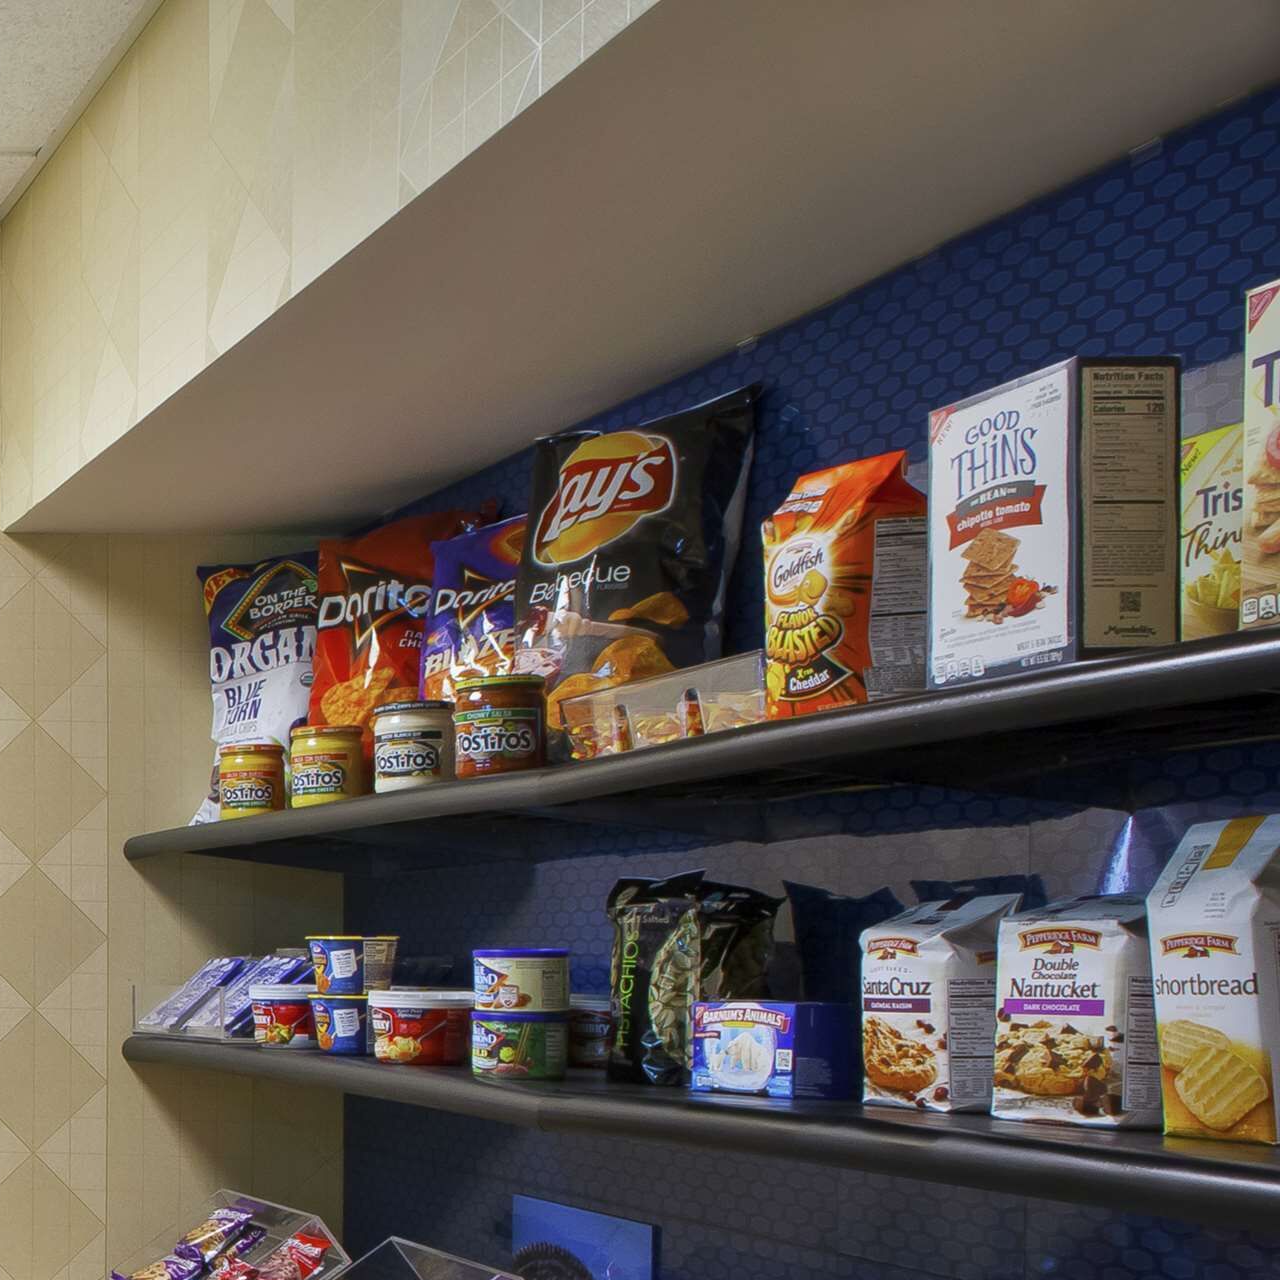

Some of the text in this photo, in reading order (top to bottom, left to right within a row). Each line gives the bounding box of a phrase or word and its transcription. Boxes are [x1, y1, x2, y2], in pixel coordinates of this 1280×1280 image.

[1093, 372, 1164, 380] Nutrition Facts
[965, 410, 1020, 445] GOOD
[951, 427, 1039, 500] THINS
[544, 453, 665, 543] Lay's
[980, 488, 1006, 504] BEAN
[1196, 481, 1243, 518] Tris
[957, 502, 1031, 532] chipotle tomato
[1181, 521, 1242, 567] Thin
[774, 548, 824, 589] Goldfish
[249, 595, 318, 619] BORDER
[255, 586, 307, 606] ON THE
[318, 579, 434, 629] Dorito
[777, 606, 816, 629] FLAVOR
[768, 617, 839, 658] BLASTED
[210, 626, 317, 683] ORGAN
[789, 668, 831, 692] Cheddar
[225, 679, 267, 708] BLUE
[1027, 930, 1097, 945] PEPPERIDGE FARM
[1167, 936, 1231, 949] PEPPERIDGE FARM
[1032, 971, 1077, 979] Chocolate
[1033, 958, 1079, 971] Double
[617, 930, 640, 1047] PISTACHIOS
[890, 977, 931, 996] Cruz
[1010, 978, 1100, 998] Nantucket
[1156, 973, 1259, 996] shortbread
[744, 1008, 785, 1027] ANIMALS
[1024, 1003, 1080, 1011] DARK CHOCOLATE
